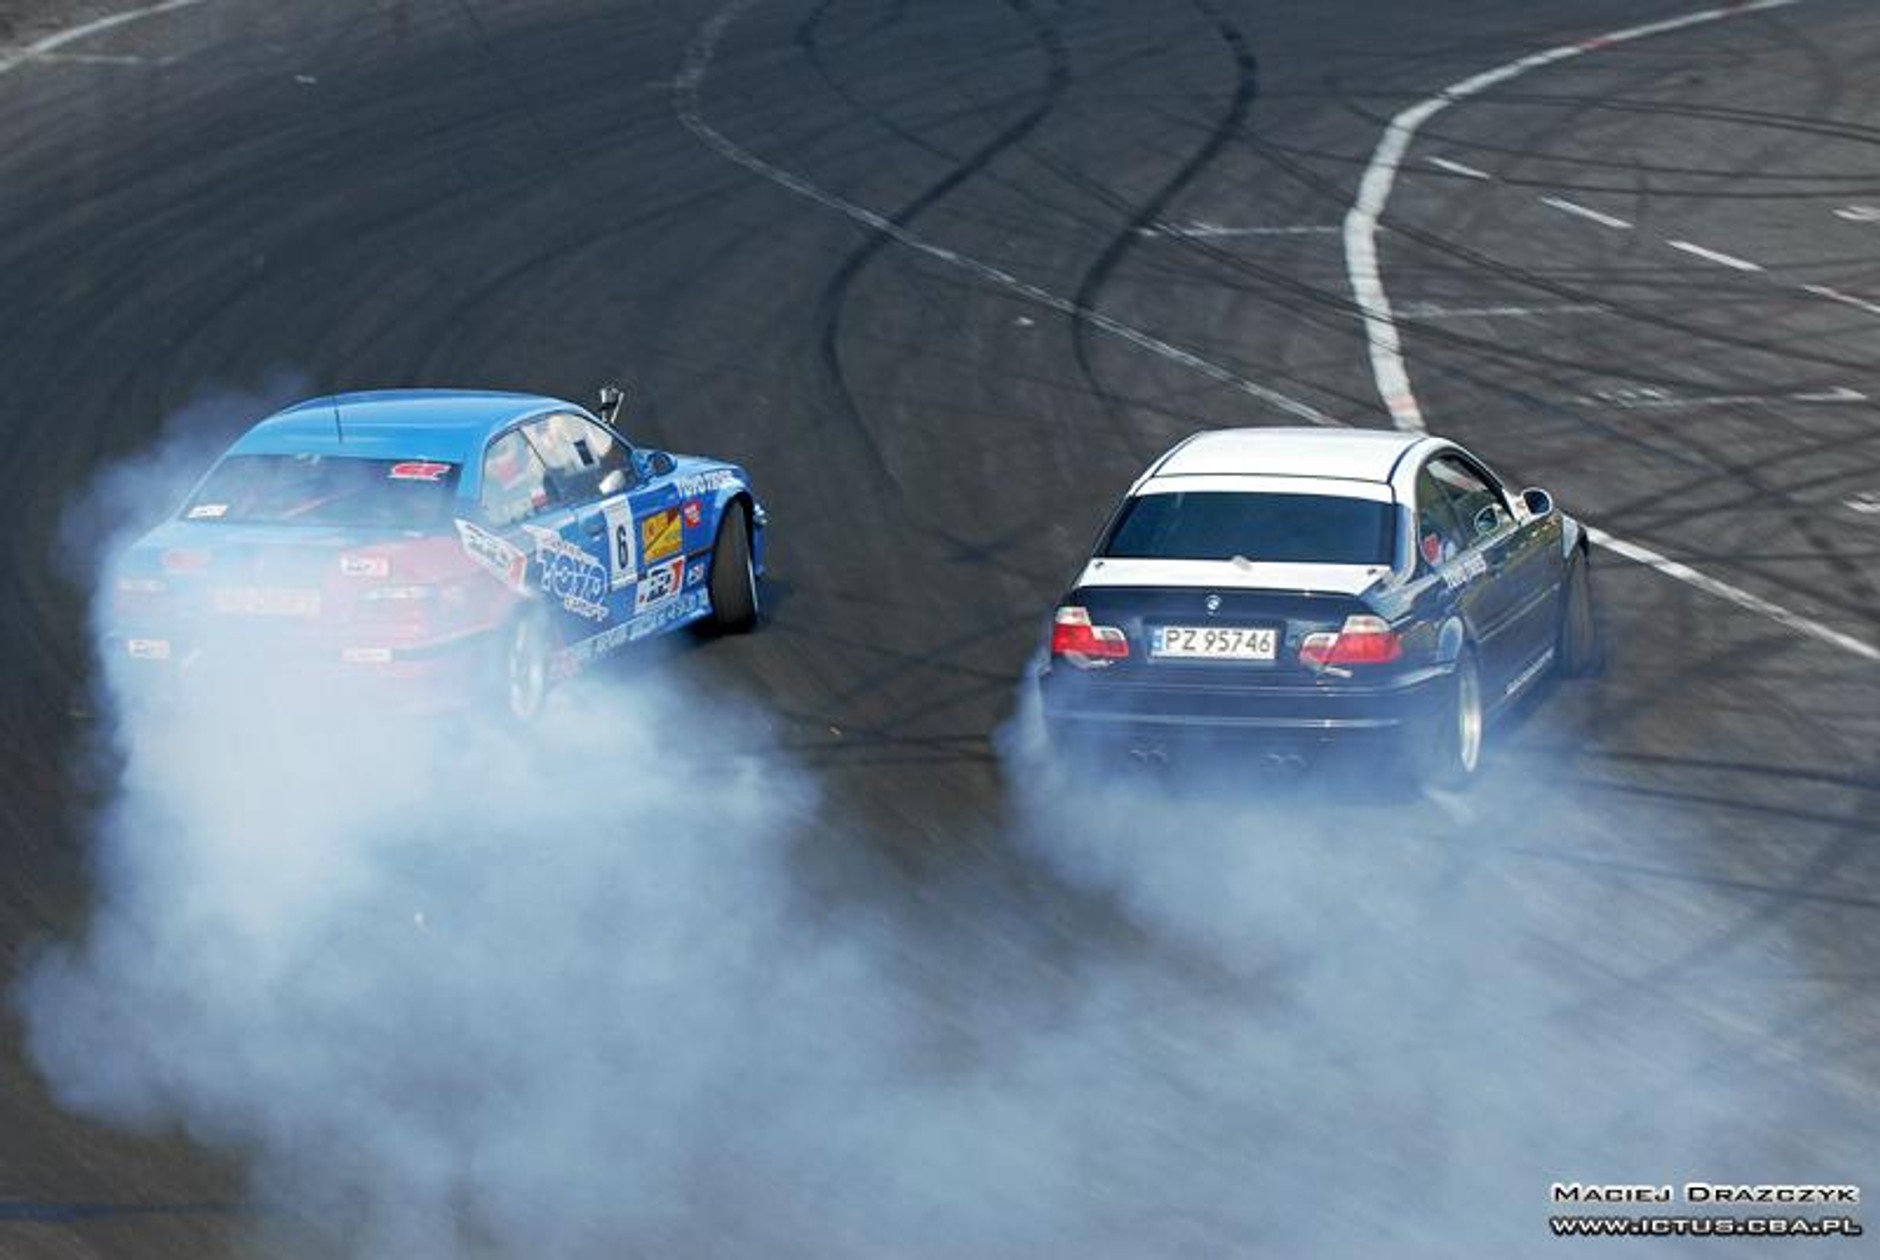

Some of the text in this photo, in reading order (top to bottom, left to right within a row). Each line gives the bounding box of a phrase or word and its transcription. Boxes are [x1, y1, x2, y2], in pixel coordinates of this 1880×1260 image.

[616, 525, 629, 570] 6
[1165, 629, 1271, 653] PZ 95746
